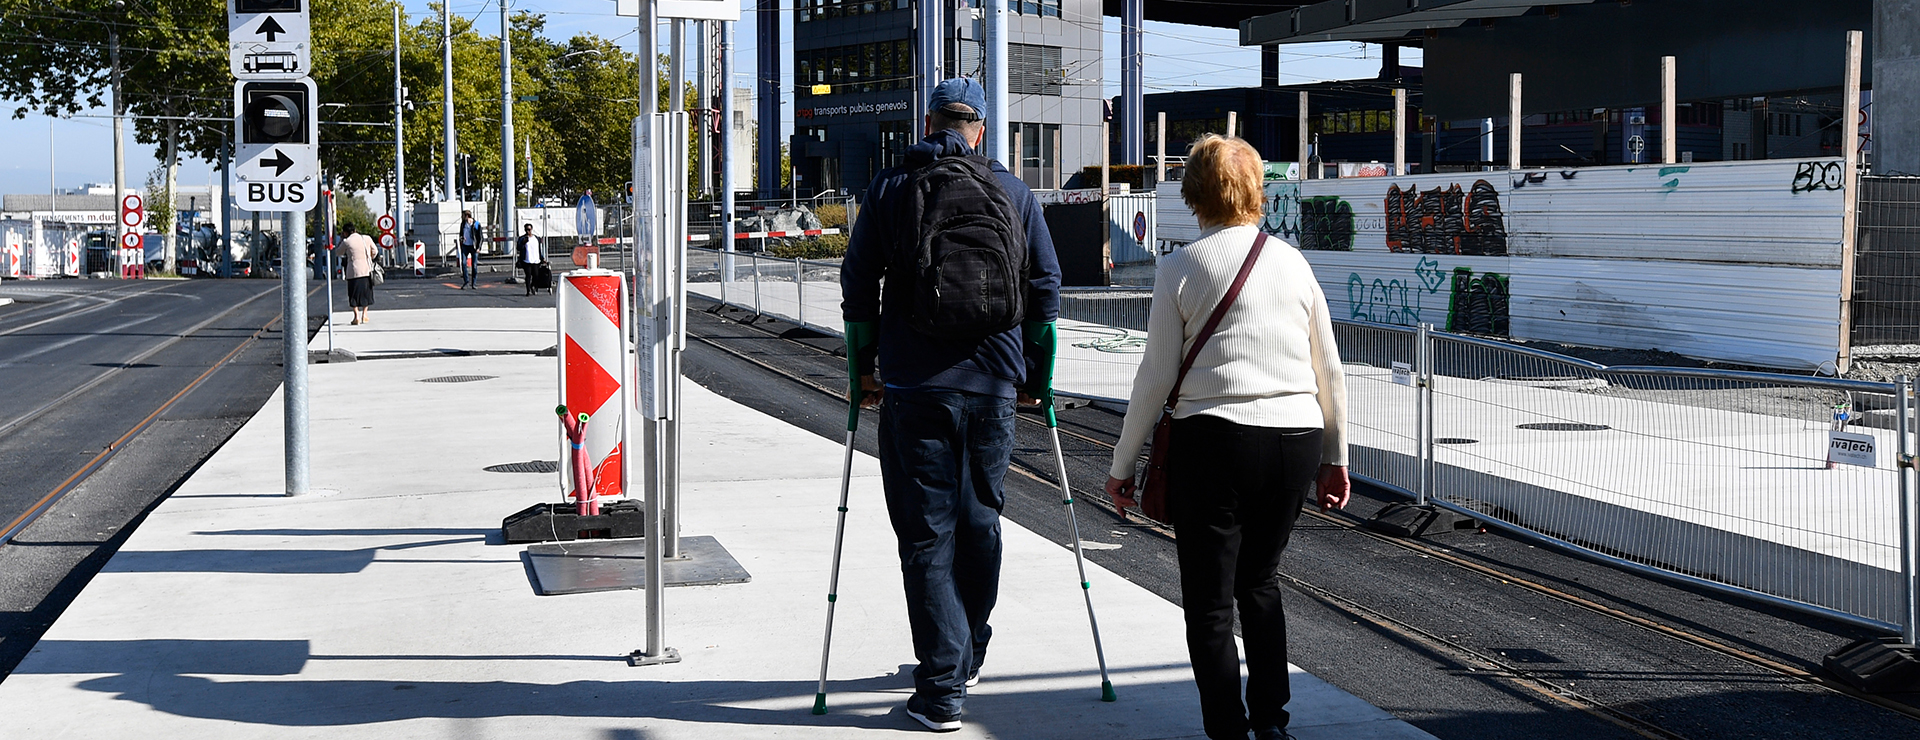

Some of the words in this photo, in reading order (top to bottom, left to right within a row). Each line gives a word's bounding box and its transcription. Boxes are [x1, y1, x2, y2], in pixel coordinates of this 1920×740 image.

[814, 106, 847, 117] transports
[850, 102, 874, 116] publics
[876, 100, 908, 114] genevois
[248, 183, 305, 203] BUS
